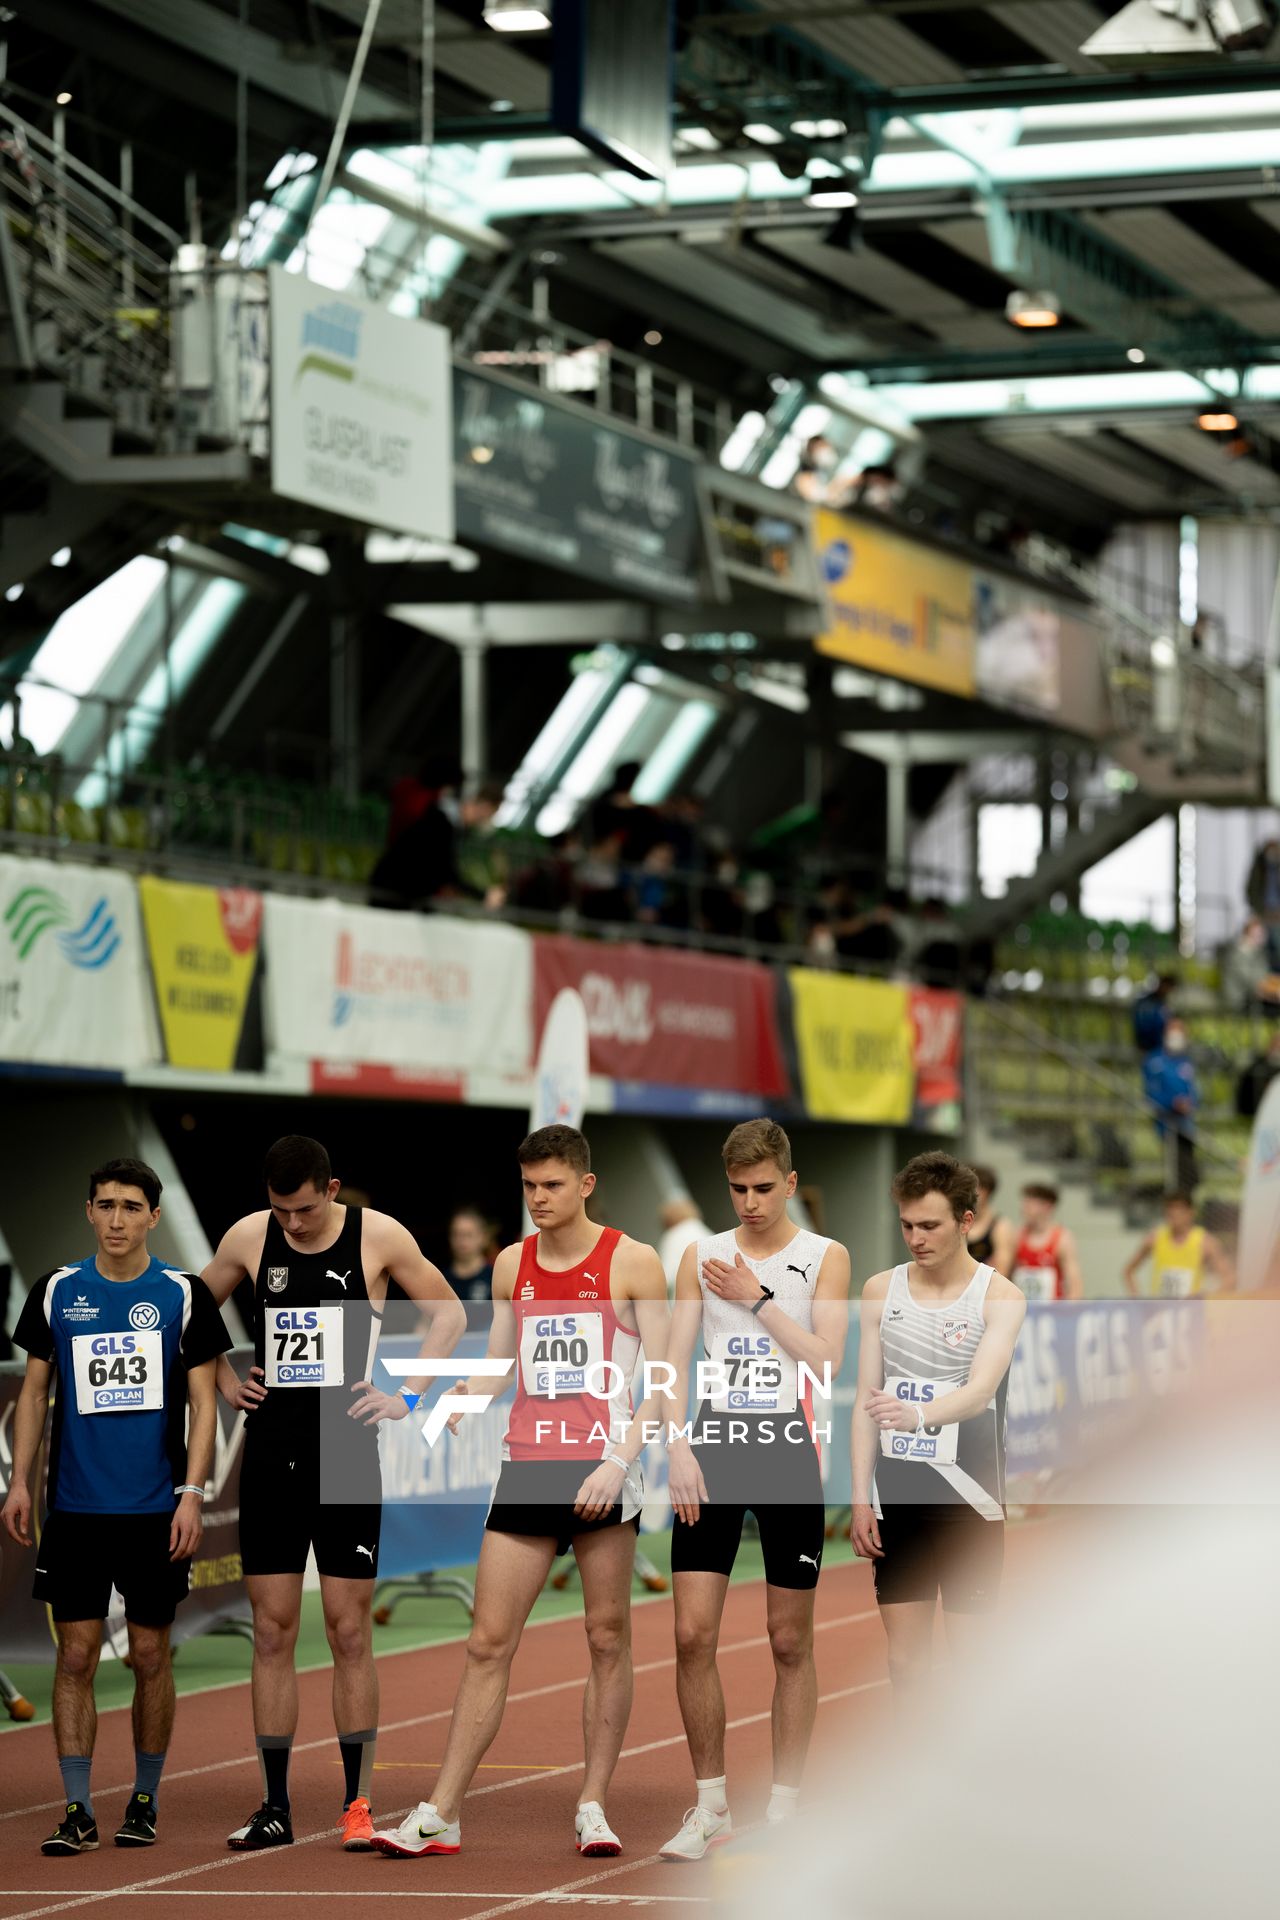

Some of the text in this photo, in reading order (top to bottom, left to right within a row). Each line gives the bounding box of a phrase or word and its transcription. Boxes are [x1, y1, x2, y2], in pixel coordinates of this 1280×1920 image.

[273, 1332, 325, 1362] 721
[532, 1337, 589, 1368] 400
[88, 1355, 148, 1387] 643
[295, 1367, 323, 1376] PLAN
[556, 1374, 583, 1383] PLAN
[114, 1390, 142, 1400] PLAN
